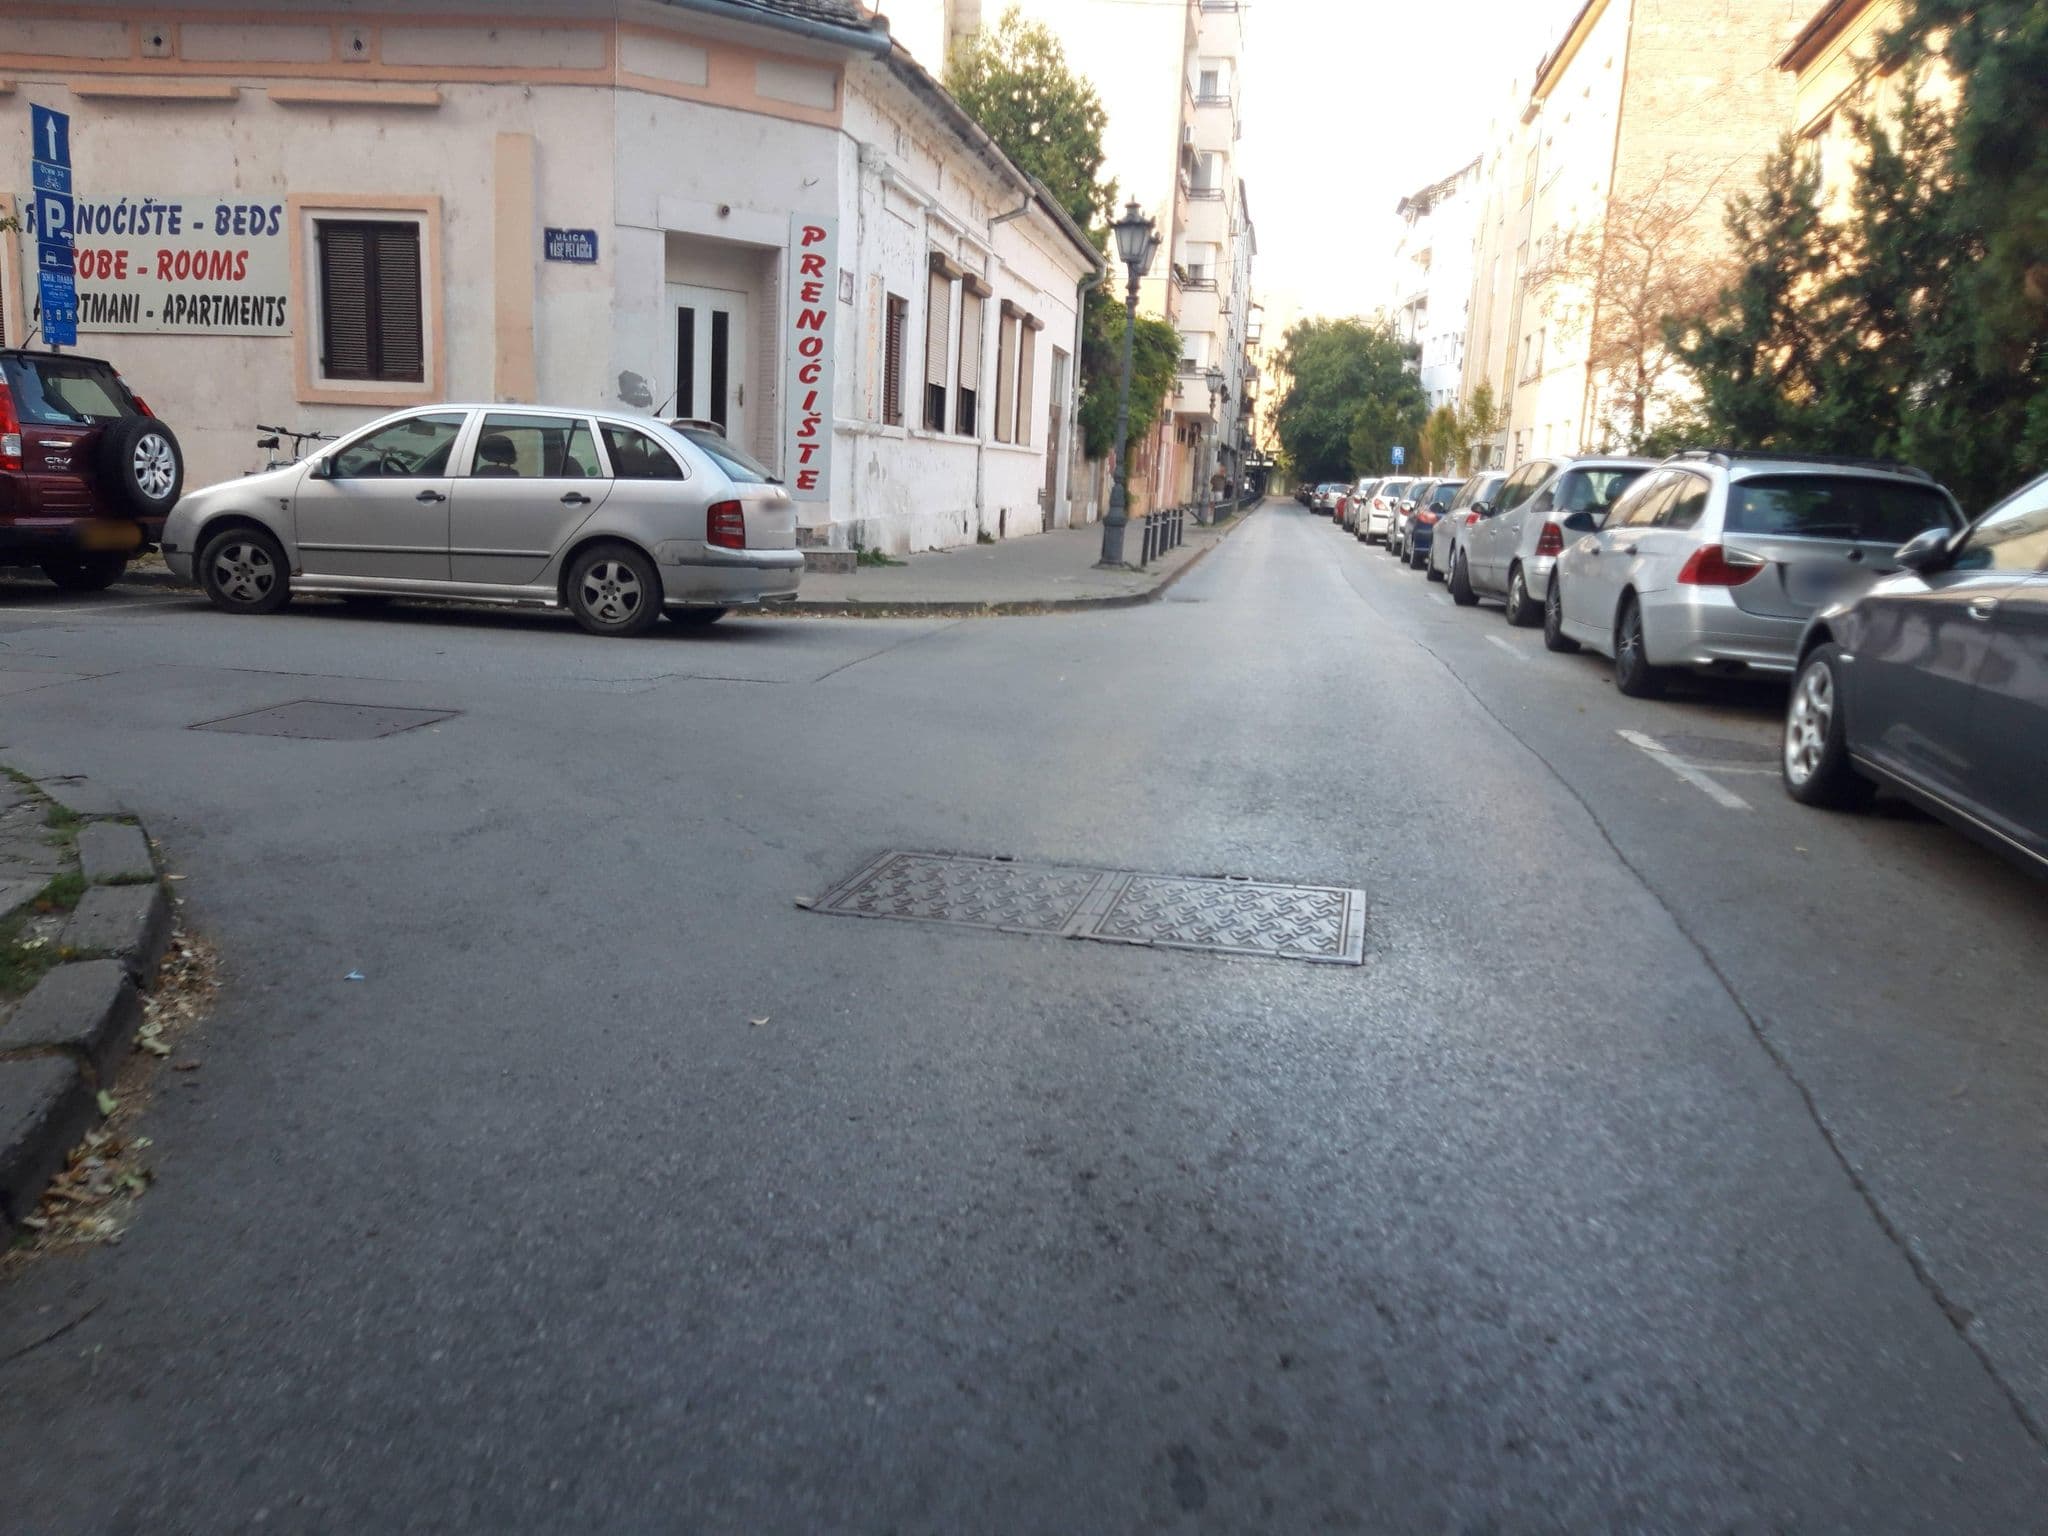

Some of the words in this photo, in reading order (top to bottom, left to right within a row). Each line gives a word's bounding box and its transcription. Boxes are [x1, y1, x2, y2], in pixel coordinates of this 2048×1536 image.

[215, 205, 282, 236] BEDS
[555, 232, 587, 242] ULICA
[156, 250, 249, 282] ROOMS
[162, 294, 287, 327] APARTMENTS
[795, 225, 827, 491] PRENOĆIŠTE
[44, 456, 72, 464] CR-V
